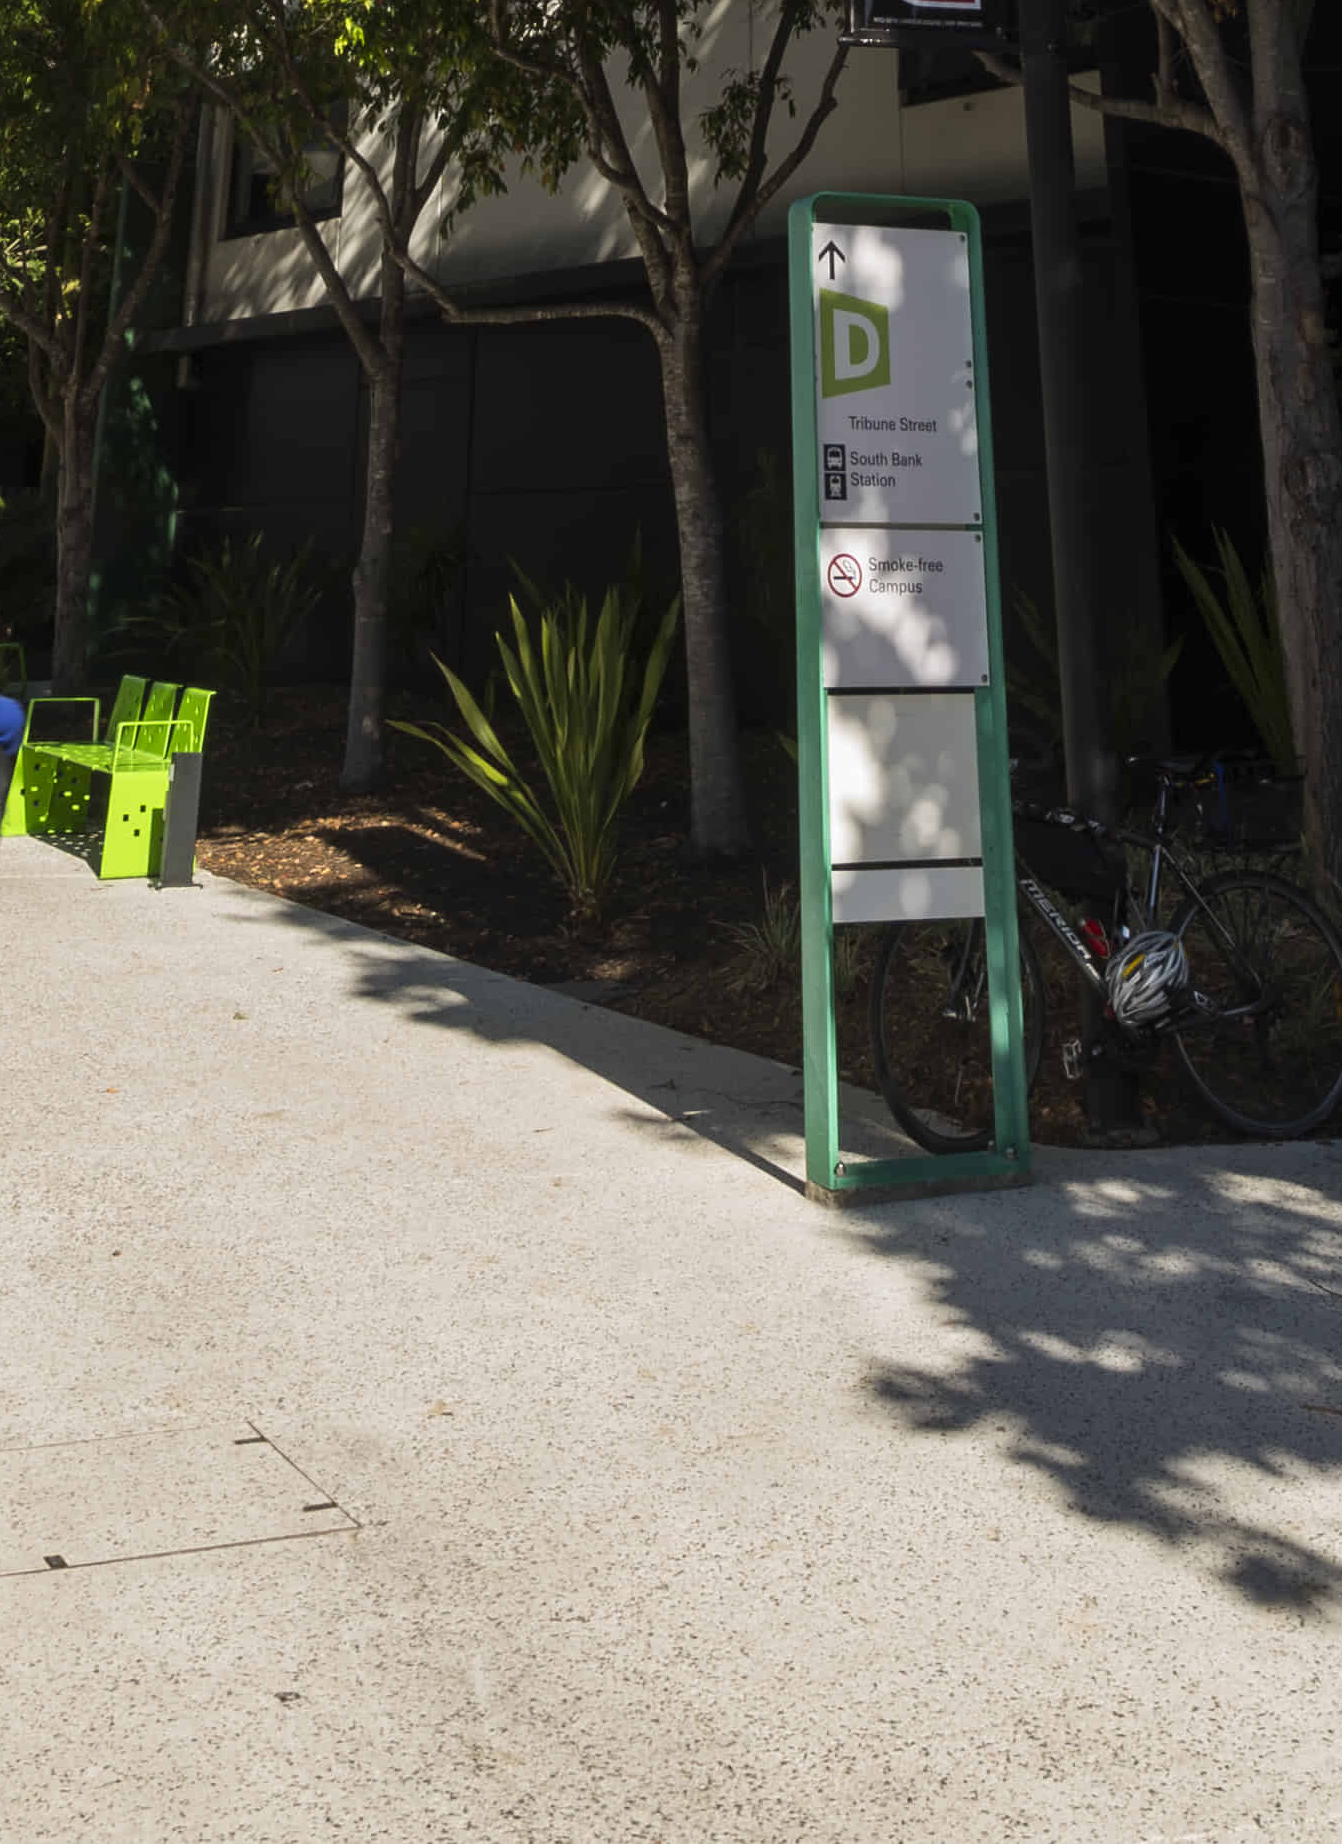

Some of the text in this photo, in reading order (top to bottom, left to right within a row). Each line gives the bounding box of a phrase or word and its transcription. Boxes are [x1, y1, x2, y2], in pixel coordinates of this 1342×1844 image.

[833, 308, 880, 381] D
[848, 416, 937, 433] Tribune Street
[850, 452, 923, 468] South Bank
[850, 473, 896, 488] Station
[869, 557, 944, 573] Smoke-free
[869, 579, 923, 595] Campus
